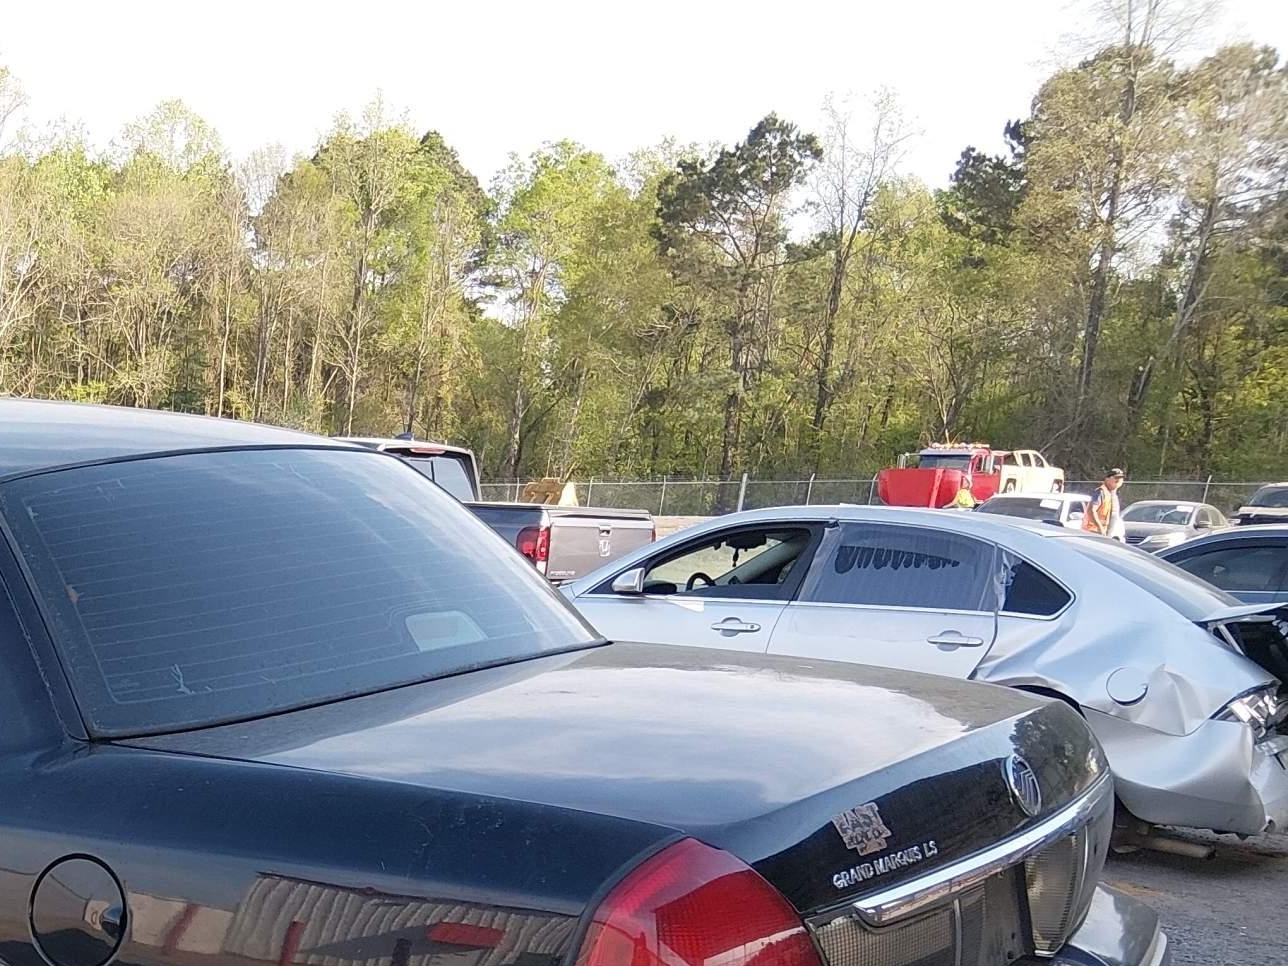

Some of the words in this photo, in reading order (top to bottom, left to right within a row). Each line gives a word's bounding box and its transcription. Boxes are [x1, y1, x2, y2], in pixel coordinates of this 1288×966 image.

[833, 863, 874, 889] GRAND
[873, 846, 923, 875] MARQUIS
[923, 840, 938, 858] LS
